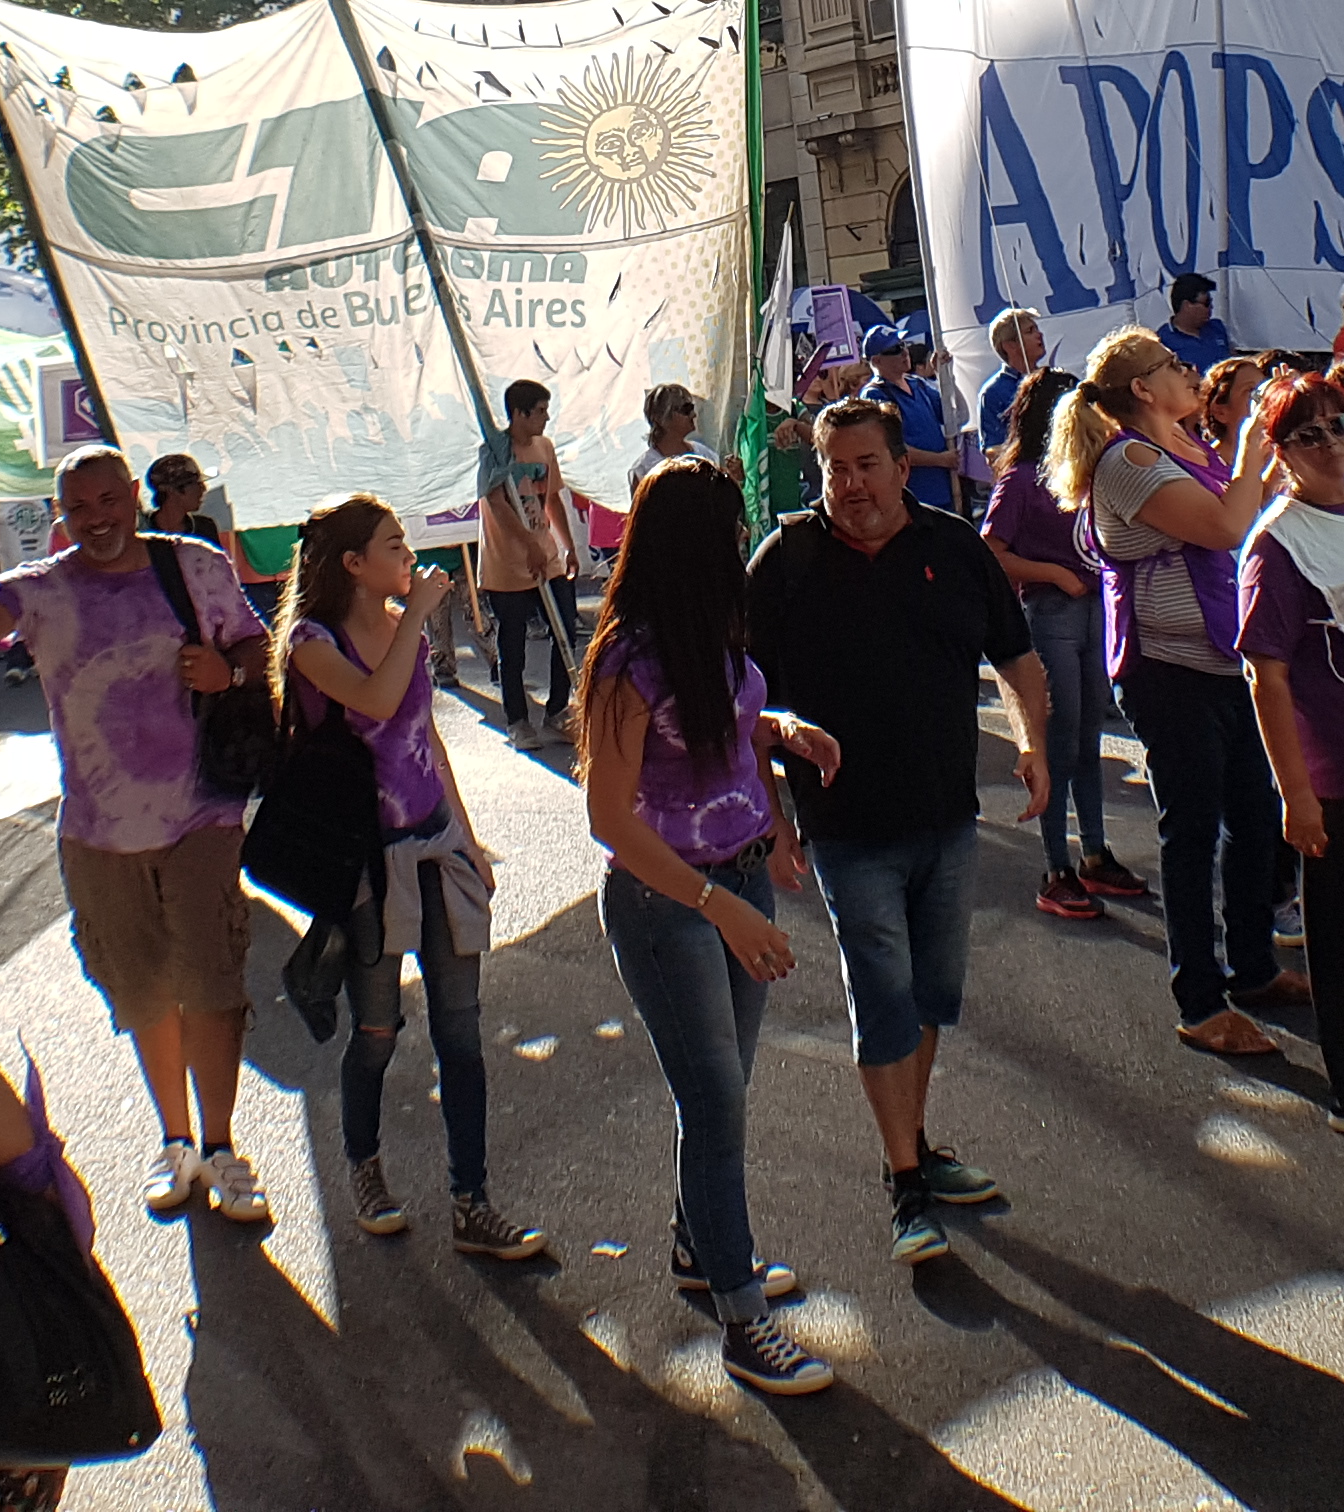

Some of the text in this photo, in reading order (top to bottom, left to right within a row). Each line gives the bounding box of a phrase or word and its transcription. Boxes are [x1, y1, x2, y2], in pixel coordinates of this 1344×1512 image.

[107, 304, 285, 345] Provincia
[296, 300, 340, 331] de
[482, 287, 588, 330] Aires
